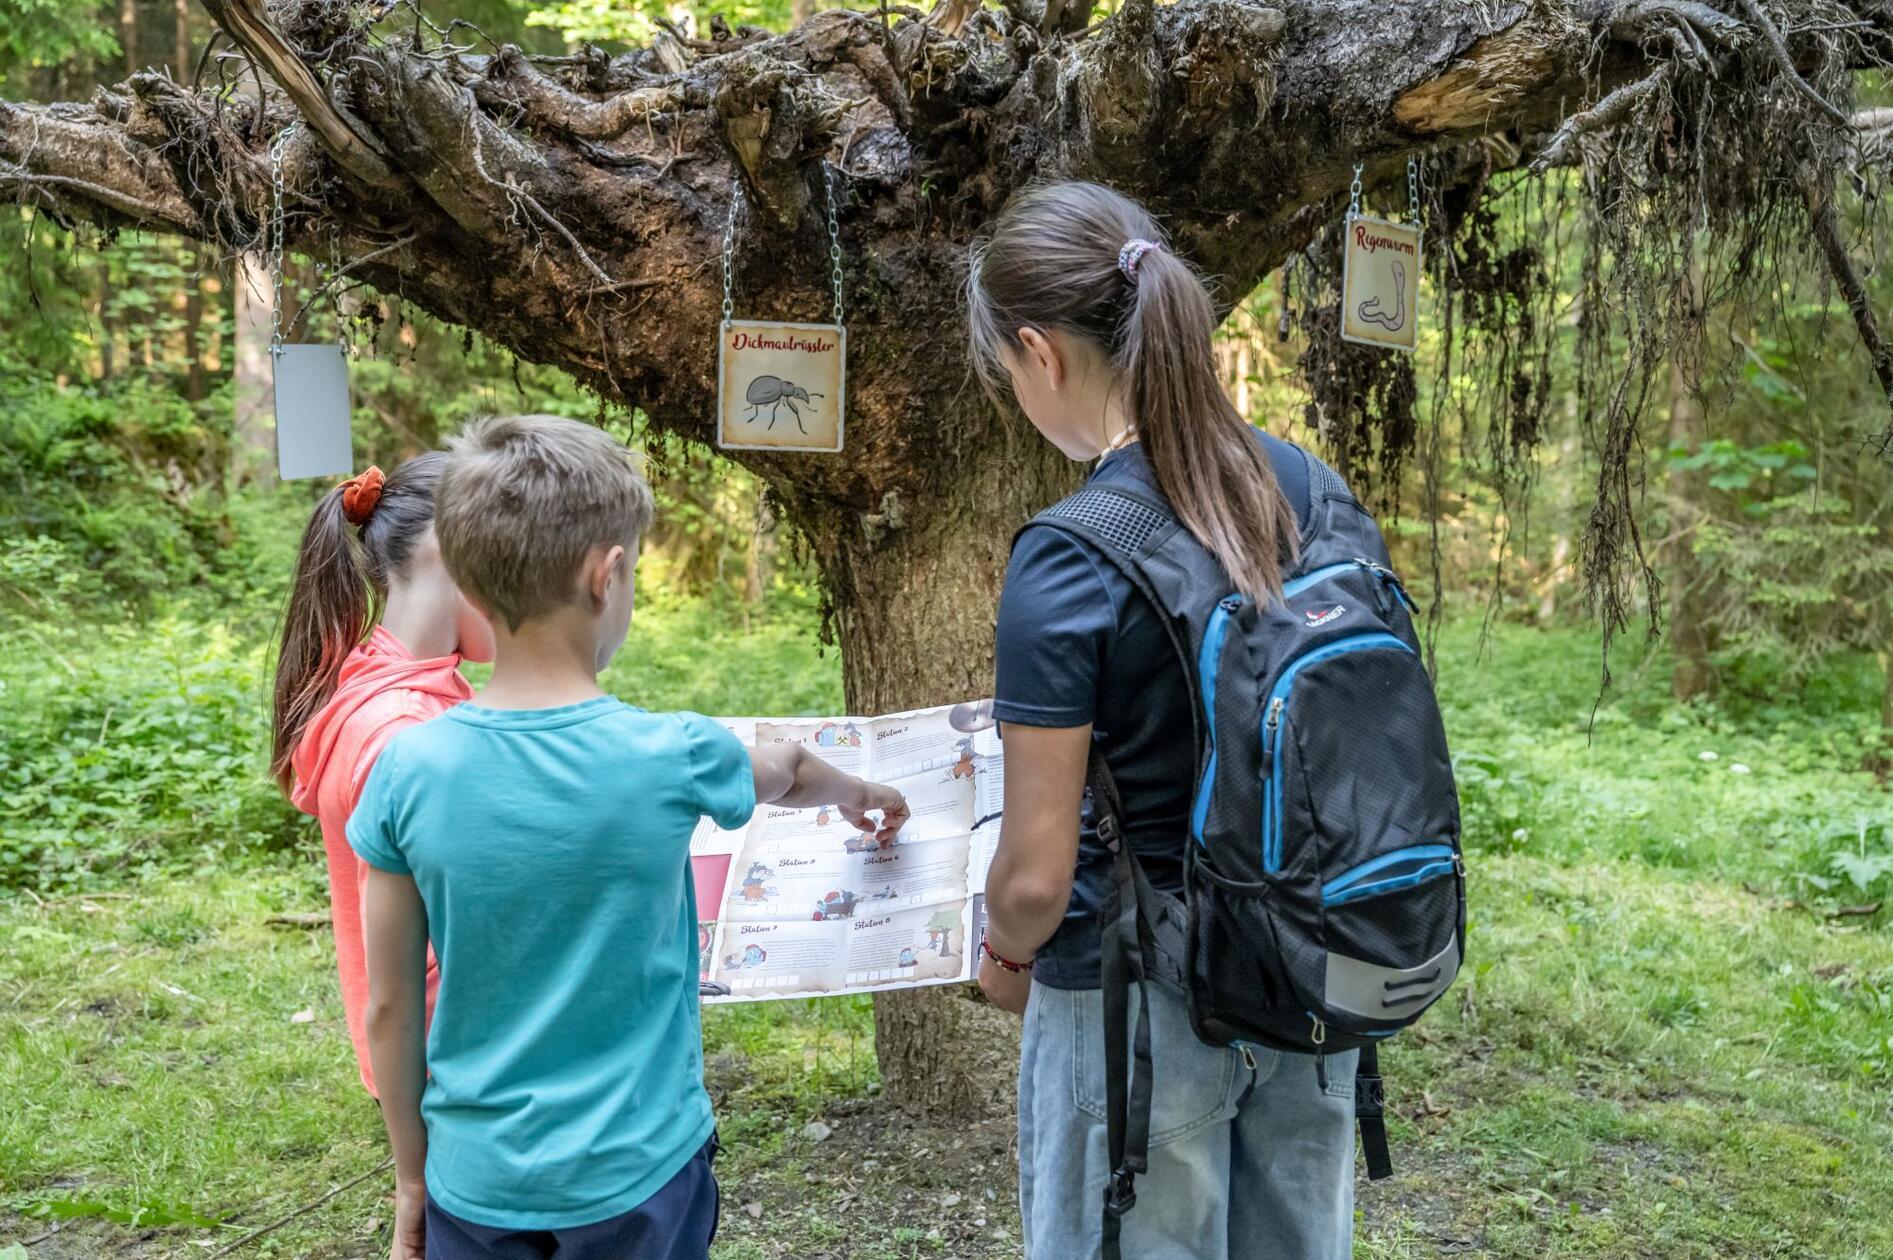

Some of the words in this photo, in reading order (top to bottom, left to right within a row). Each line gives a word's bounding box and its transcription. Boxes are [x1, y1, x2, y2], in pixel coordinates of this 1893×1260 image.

[1355, 225, 1414, 256] Regenwurm
[732, 333, 834, 353] Dickmaulrüssler
[767, 810, 795, 818] Station
[779, 859, 808, 867] Station
[864, 856, 892, 865] Station
[854, 919, 883, 930] Station
[741, 925, 770, 934] Station
